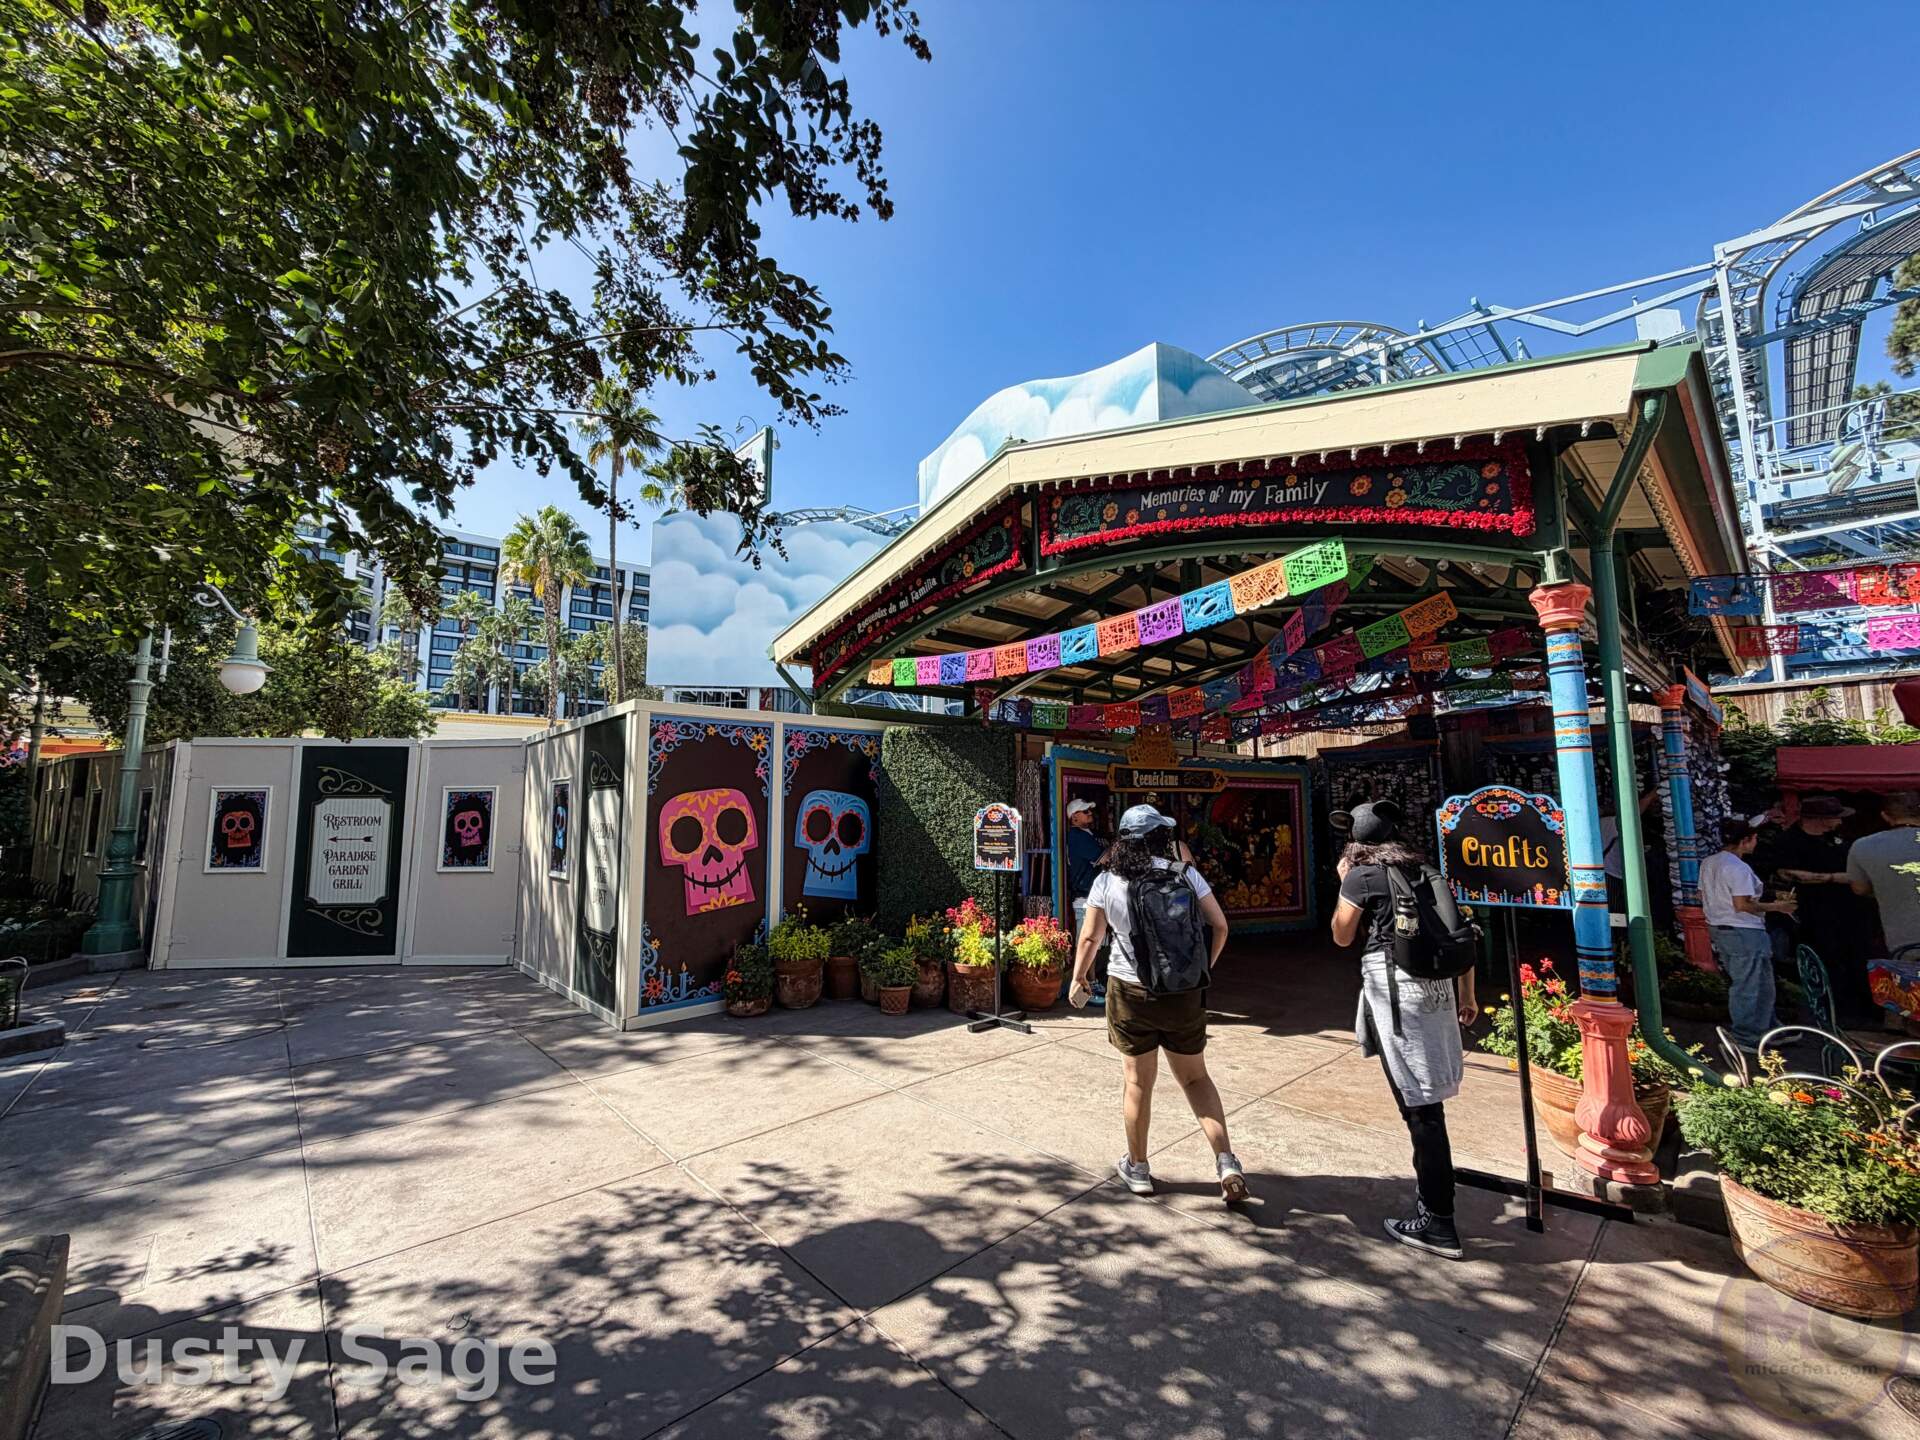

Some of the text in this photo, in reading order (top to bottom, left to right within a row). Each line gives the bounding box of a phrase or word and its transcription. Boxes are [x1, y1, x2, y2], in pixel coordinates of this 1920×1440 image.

[1140, 478, 1330, 511] Memories of my Family
[899, 596, 909, 609] mi
[910, 577, 938, 604] Familia
[1476, 802, 1522, 814] COCO
[323, 813, 382, 831] RESTROOM
[323, 849, 377, 865] PARADISE
[1461, 835, 1549, 869] Crafts
[328, 865, 369, 876] GARDEN
[332, 878, 363, 890] GRILL
